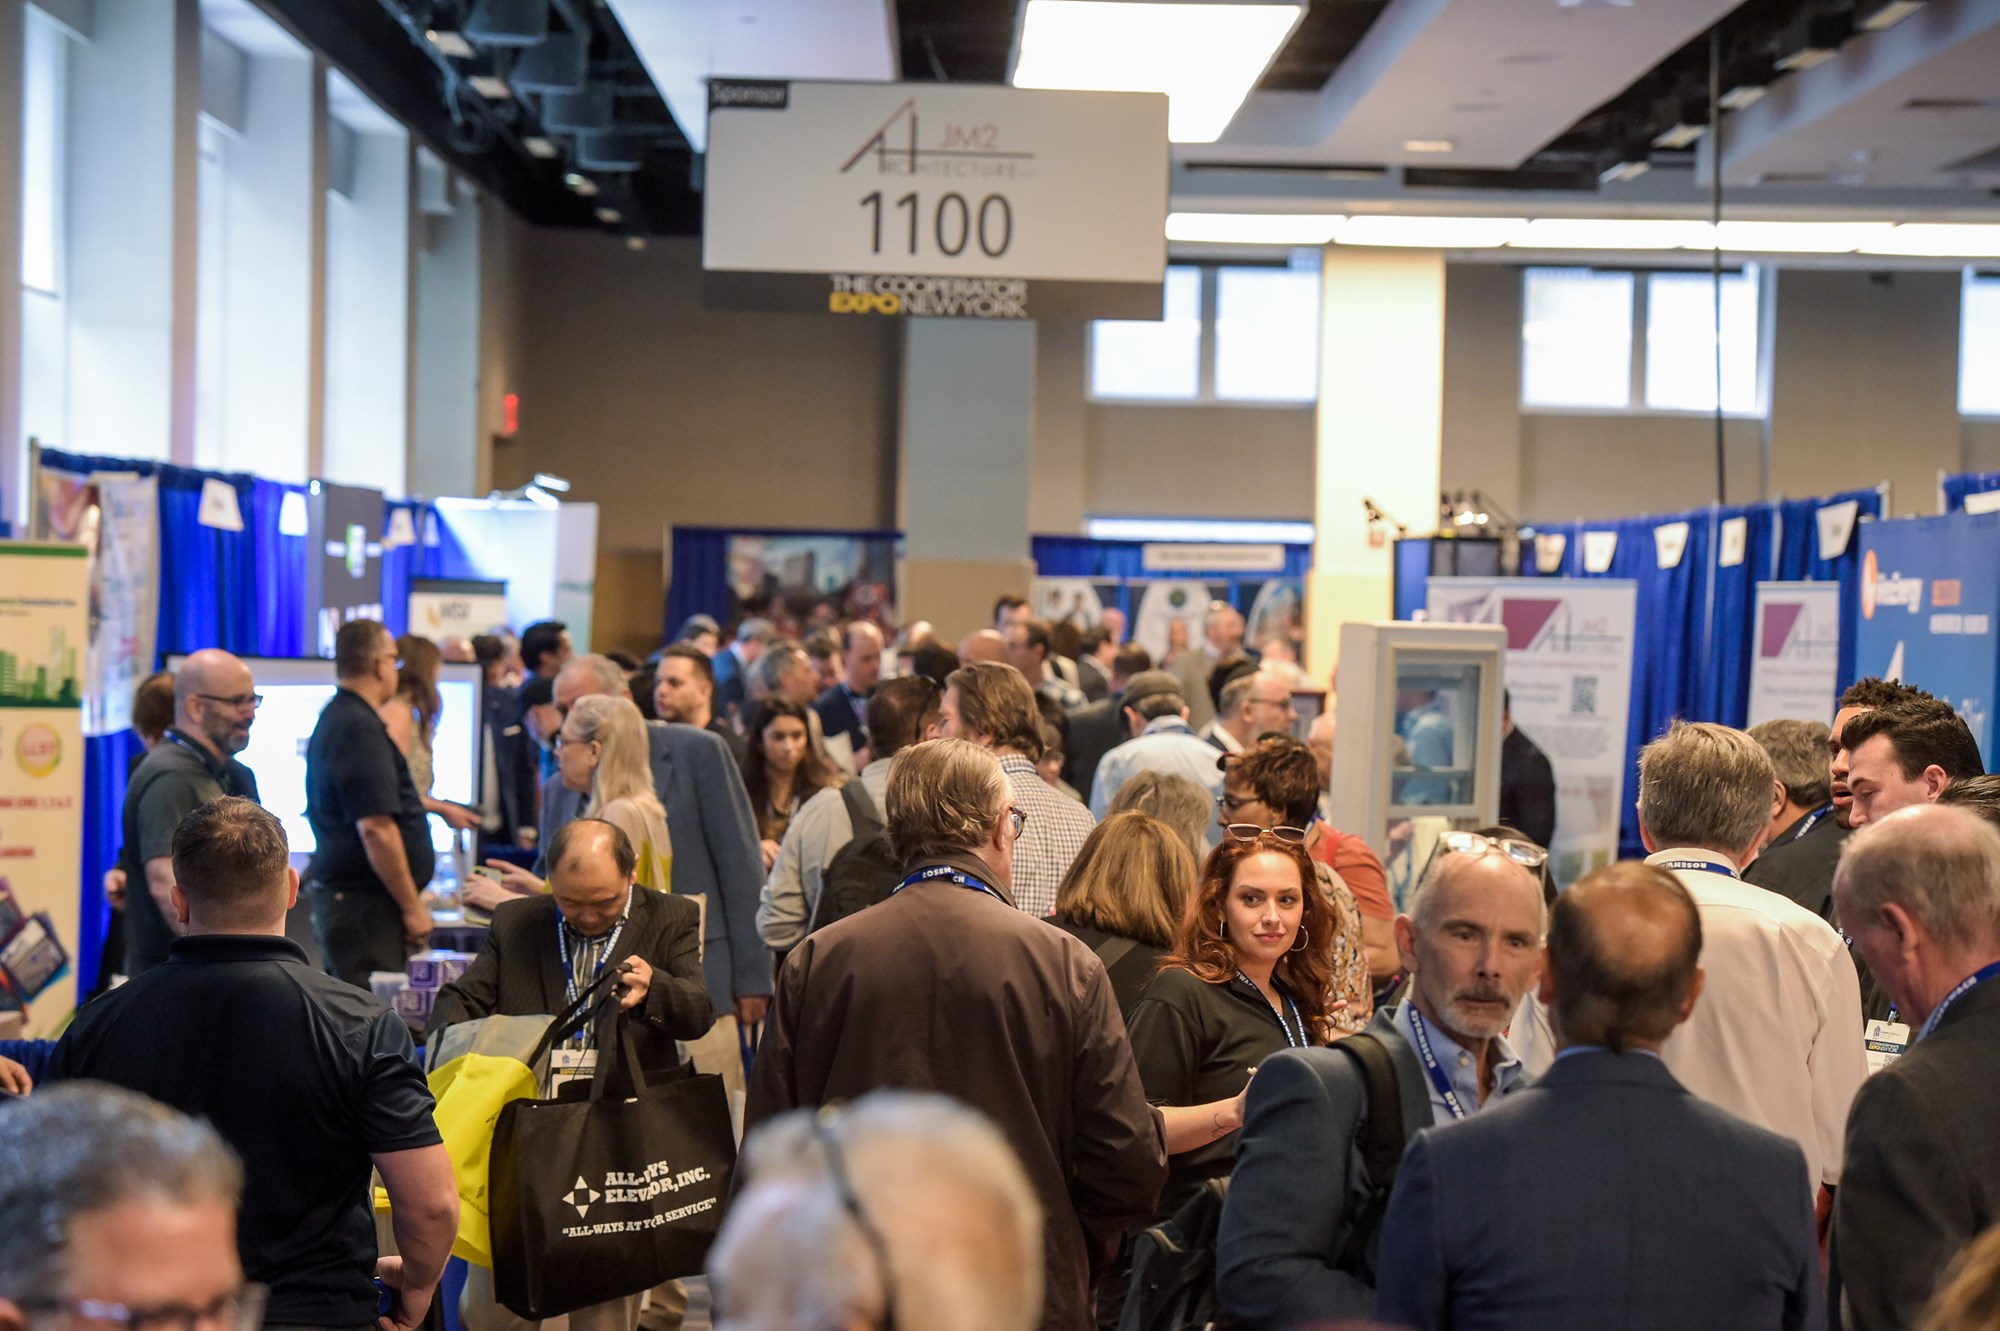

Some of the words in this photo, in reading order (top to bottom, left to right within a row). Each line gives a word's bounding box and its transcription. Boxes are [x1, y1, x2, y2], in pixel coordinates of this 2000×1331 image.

[860, 190, 1013, 258] 1100
[831, 274, 873, 294] THE
[875, 275, 1028, 299] COOPERATOR
[922, 866, 966, 884] ROSENCH
[1411, 1010, 1436, 1069] ROSENWACH
[605, 1160, 670, 1187] ALL-YS
[605, 1178, 679, 1204] ELEVOR,
[626, 1221, 642, 1232] AT
